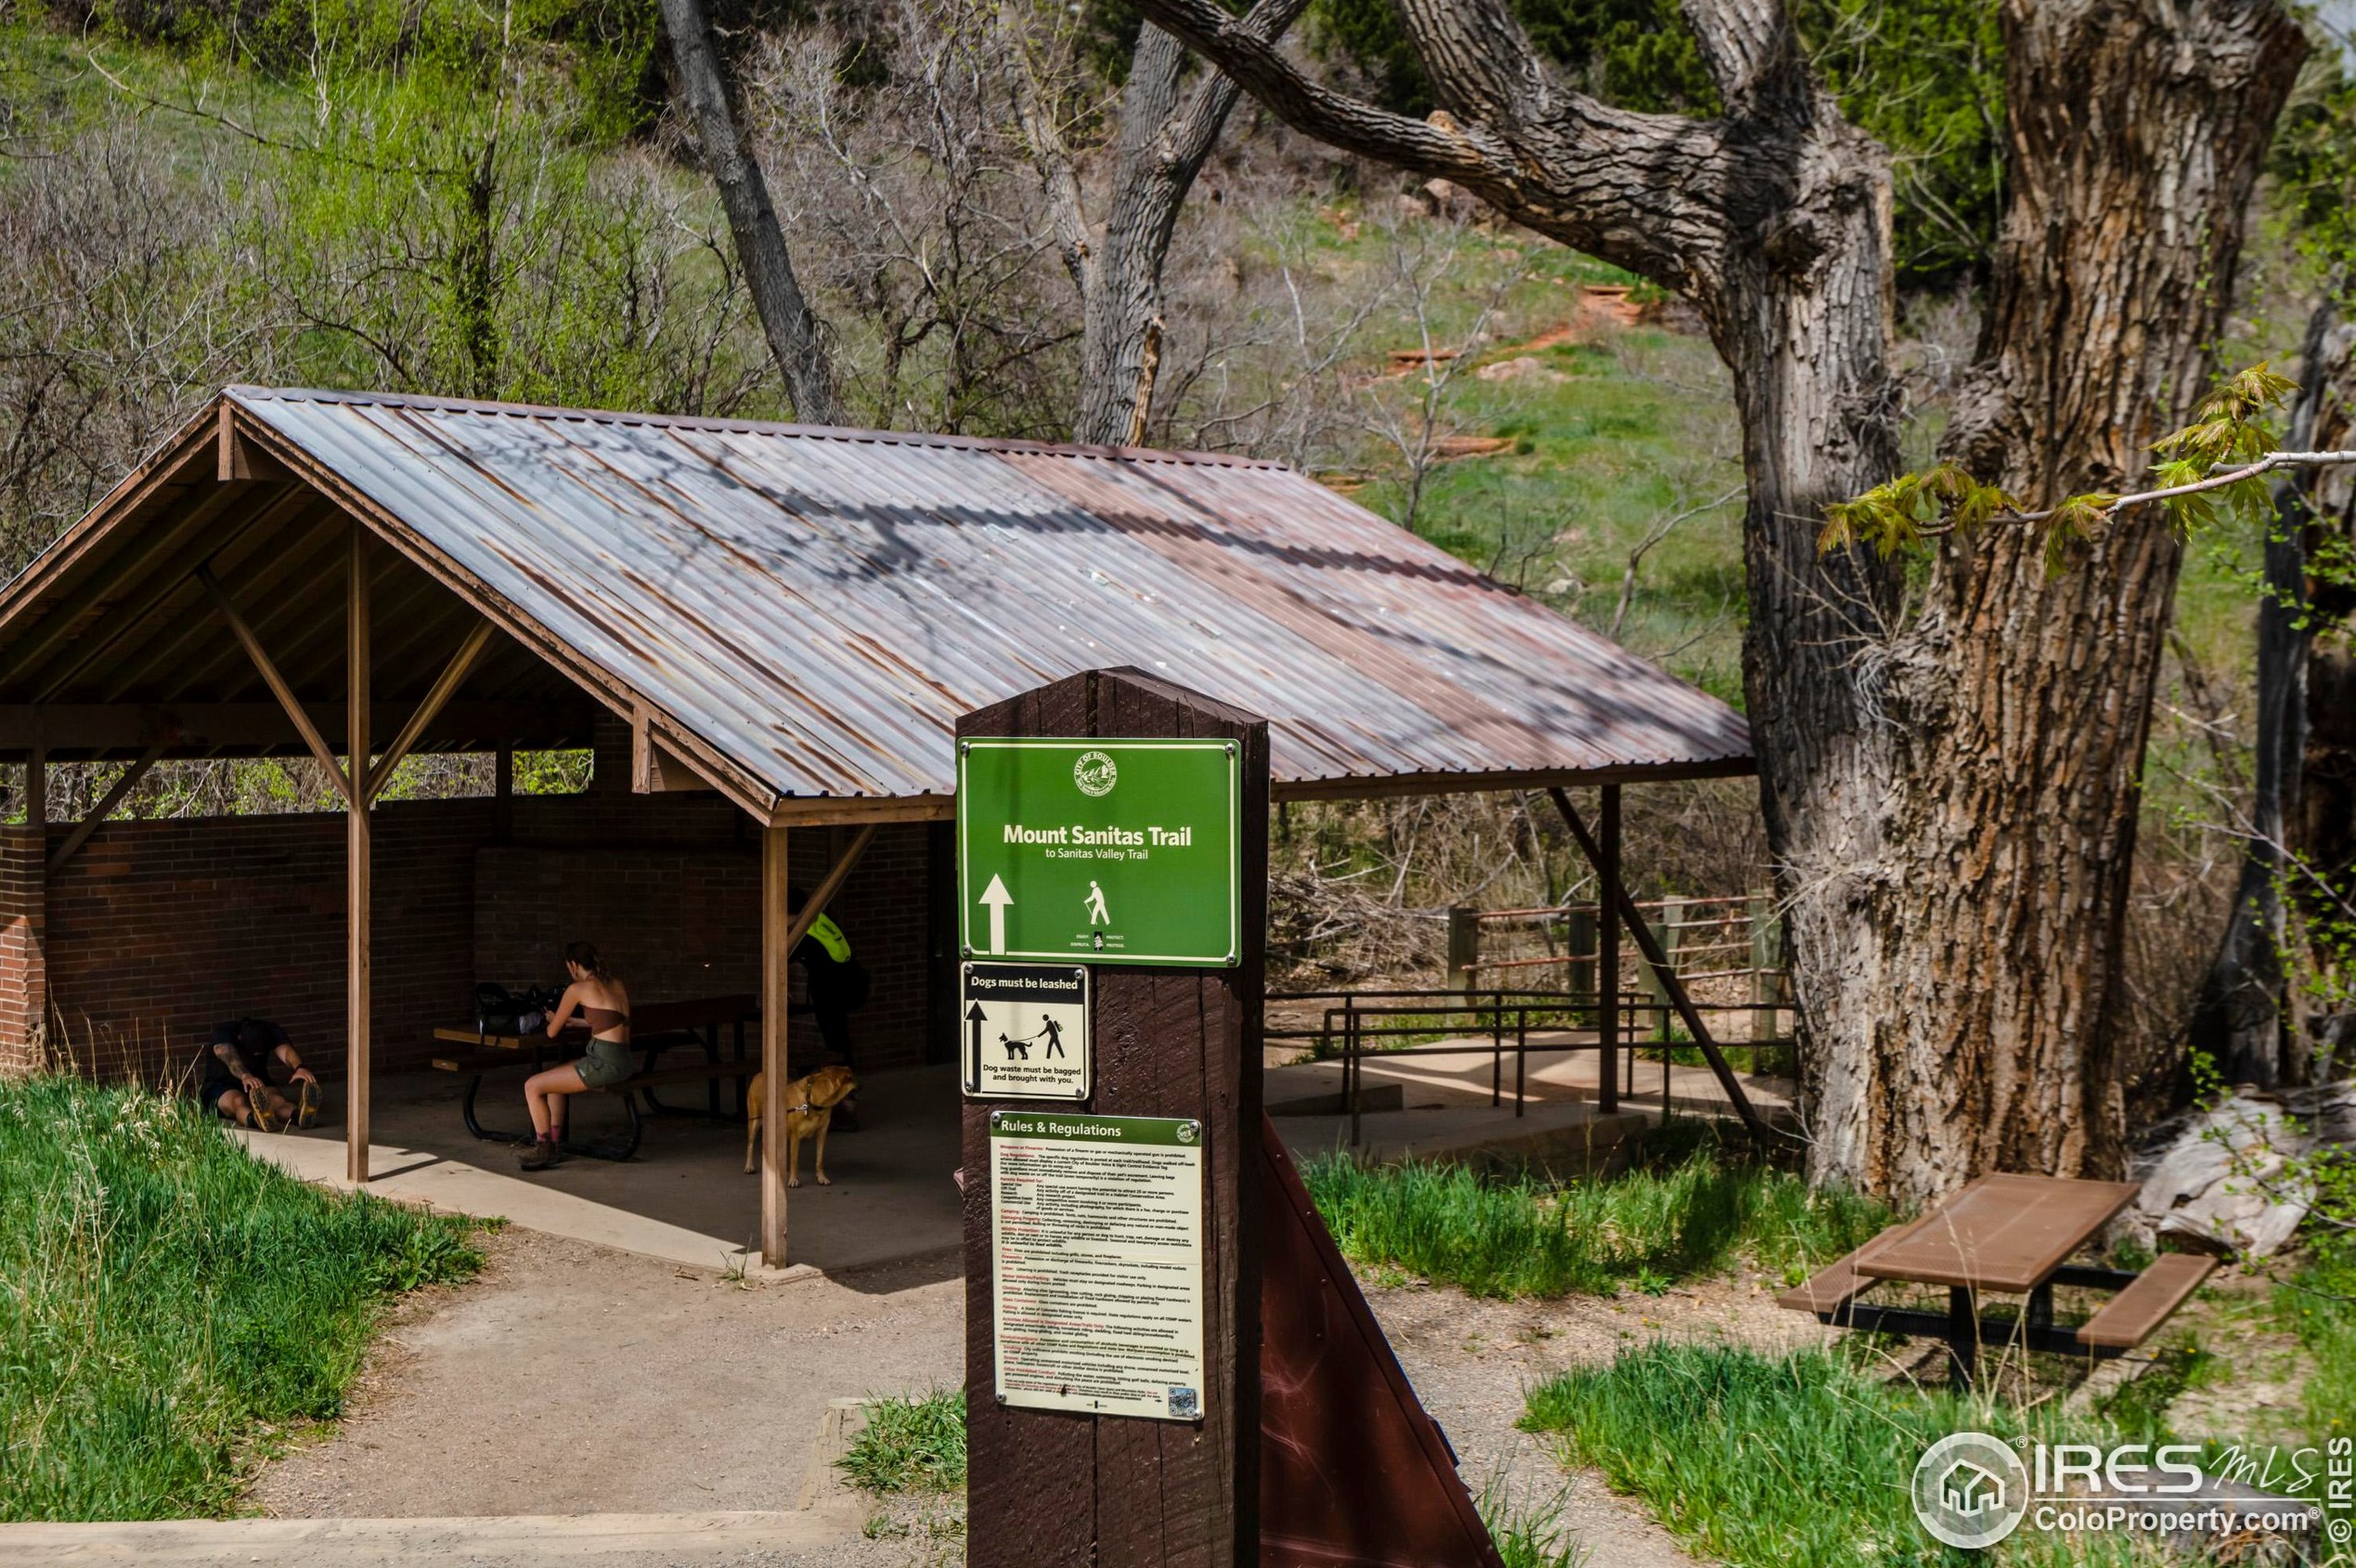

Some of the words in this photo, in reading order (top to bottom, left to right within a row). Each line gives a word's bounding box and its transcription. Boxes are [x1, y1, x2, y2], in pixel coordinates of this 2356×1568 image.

[1003, 824, 1068, 844] Mount
[1071, 825, 1144, 846] Sanitas
[1148, 826, 1192, 847] Trail
[1045, 849, 1055, 858] to
[1057, 848, 1094, 859] Sanitas
[1095, 849, 1124, 862] Valley
[1127, 849, 1148, 860] Trail
[971, 977, 996, 989] Dogs
[998, 978, 1023, 988] must
[1025, 978, 1038, 988] be
[1039, 978, 1078, 990] leashed
[1054, 1067, 1081, 1076] bagged
[1008, 1074, 1037, 1083] brought
[1001, 1120, 1033, 1133] Rules
[1036, 1121, 1046, 1133] &
[1049, 1122, 1121, 1136] Regulations
